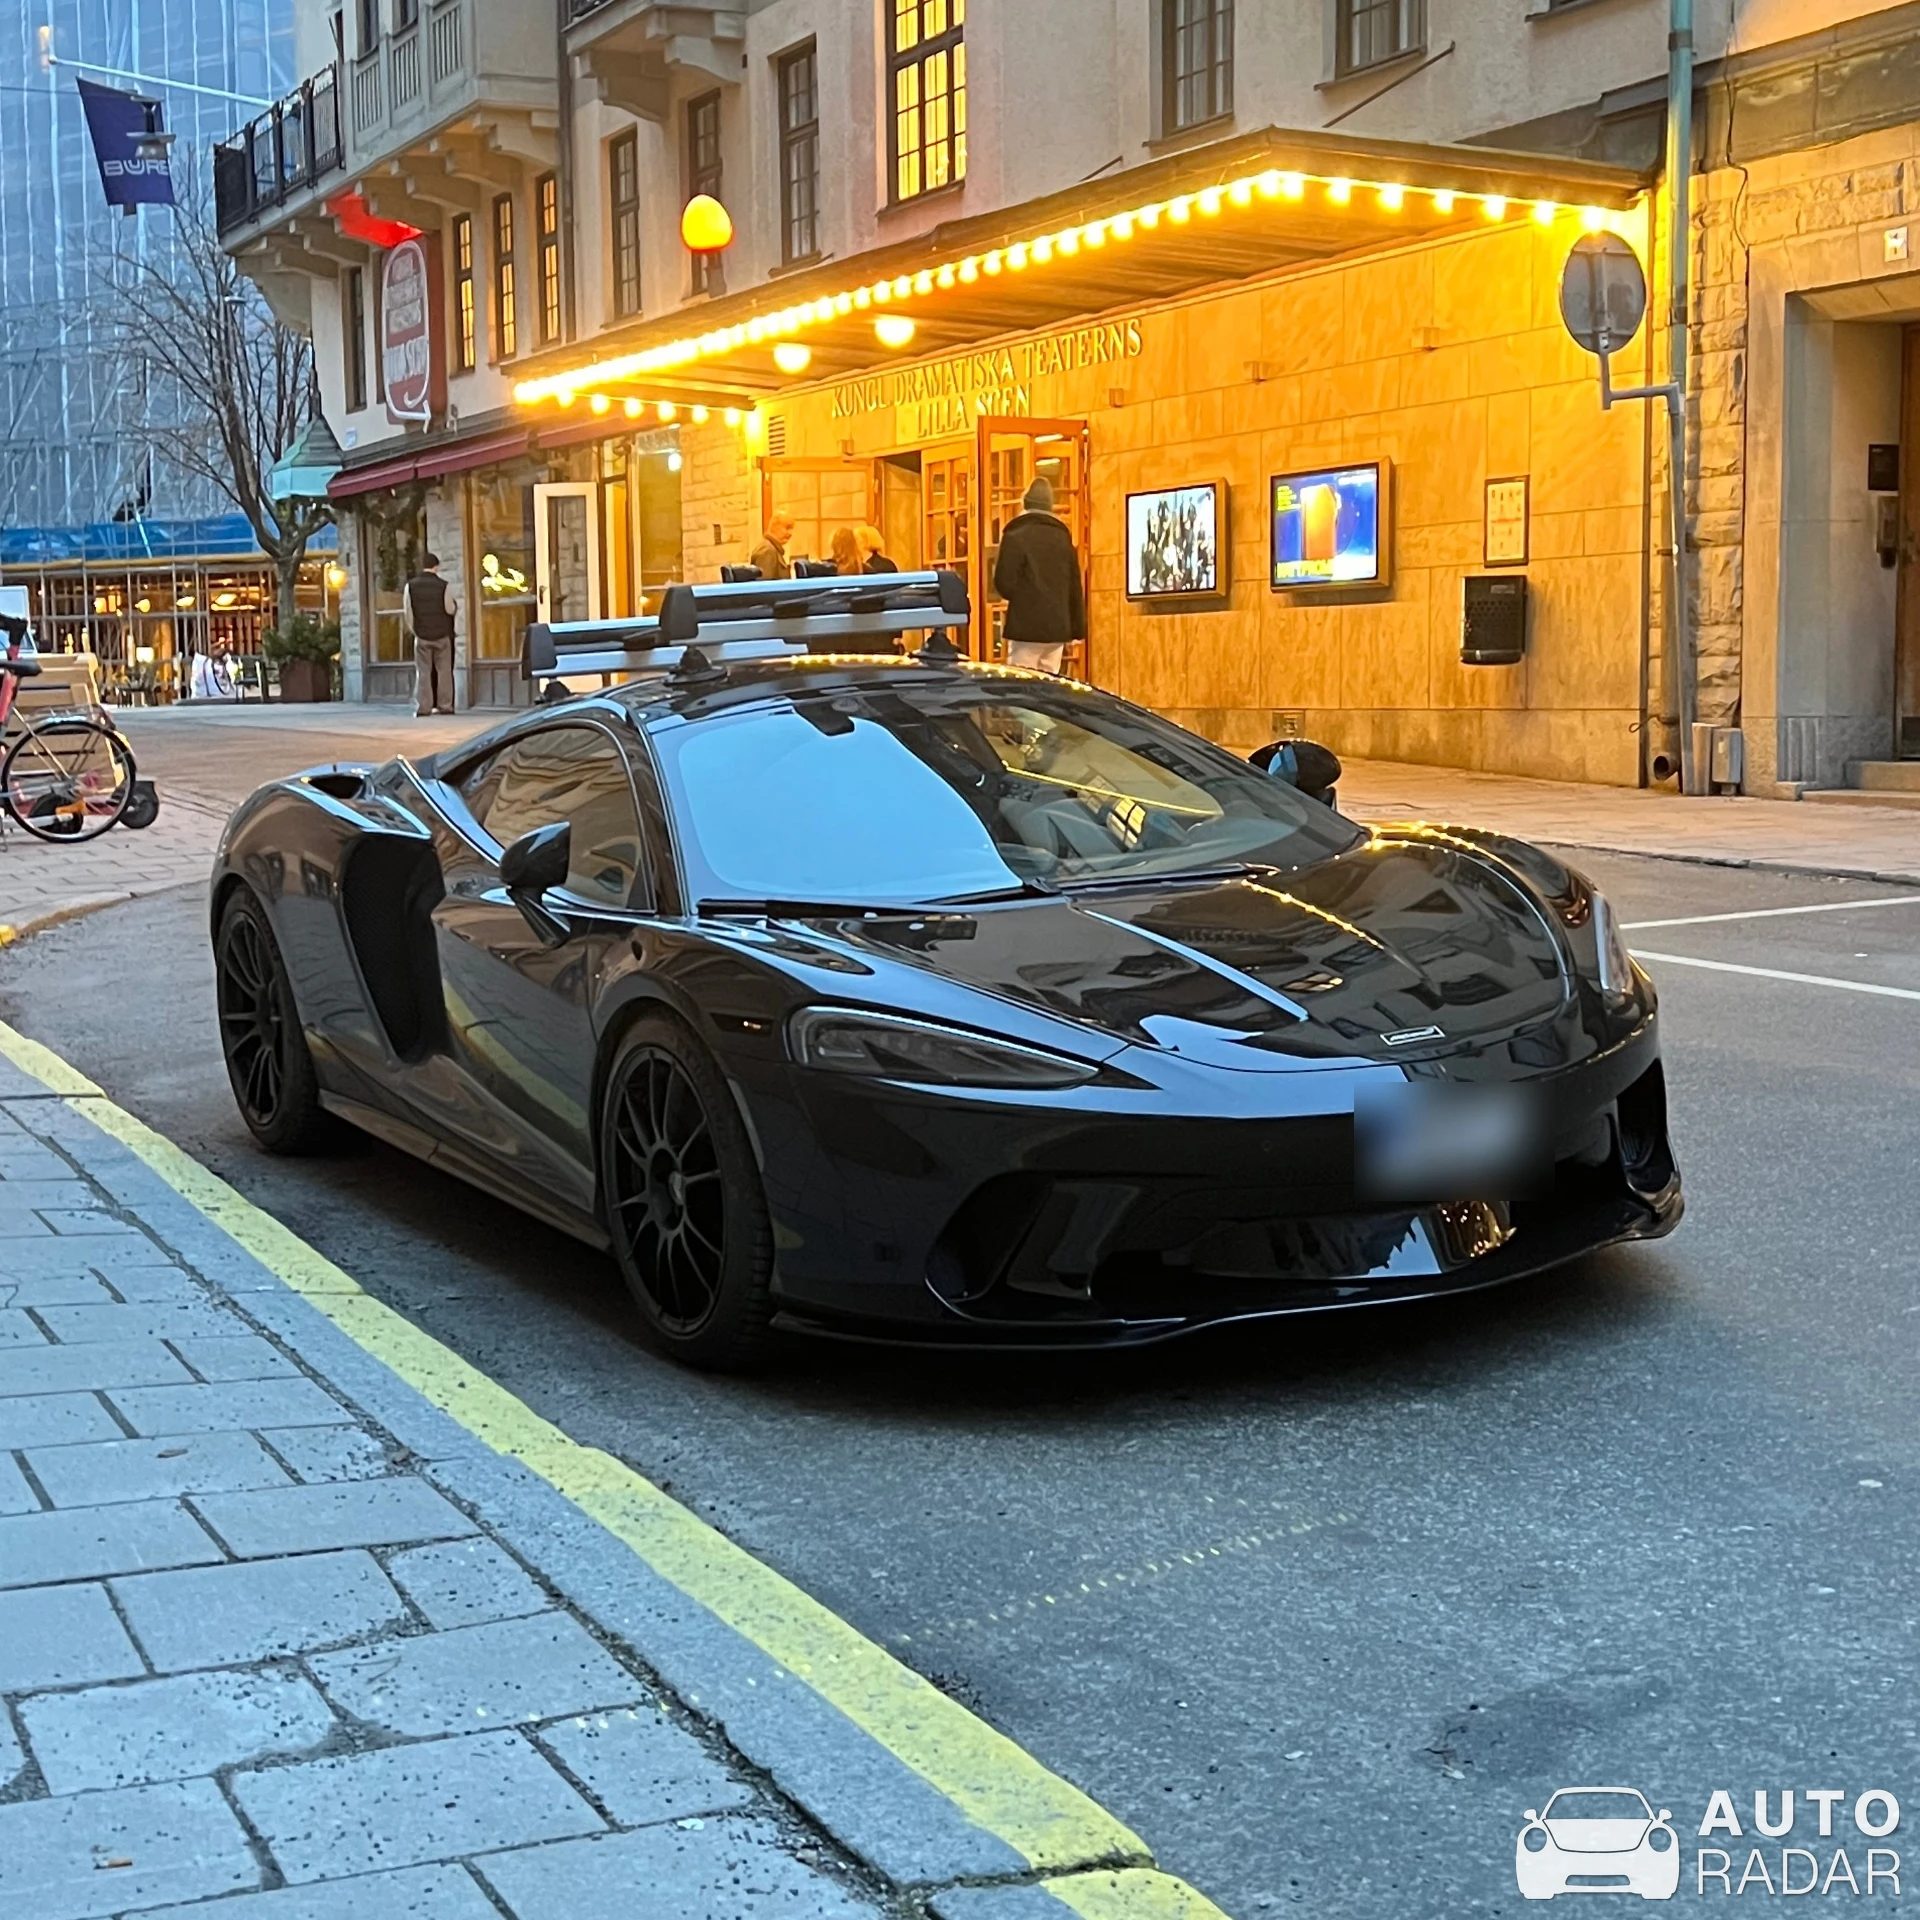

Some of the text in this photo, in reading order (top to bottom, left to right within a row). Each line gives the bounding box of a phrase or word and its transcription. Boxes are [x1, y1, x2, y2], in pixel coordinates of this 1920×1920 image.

[103, 159, 168, 176] BURE
[894, 348, 1015, 406] DRAMATISKA
[1023, 318, 1142, 378] TEATERNS
[917, 382, 1032, 437] LILLA SCEN
